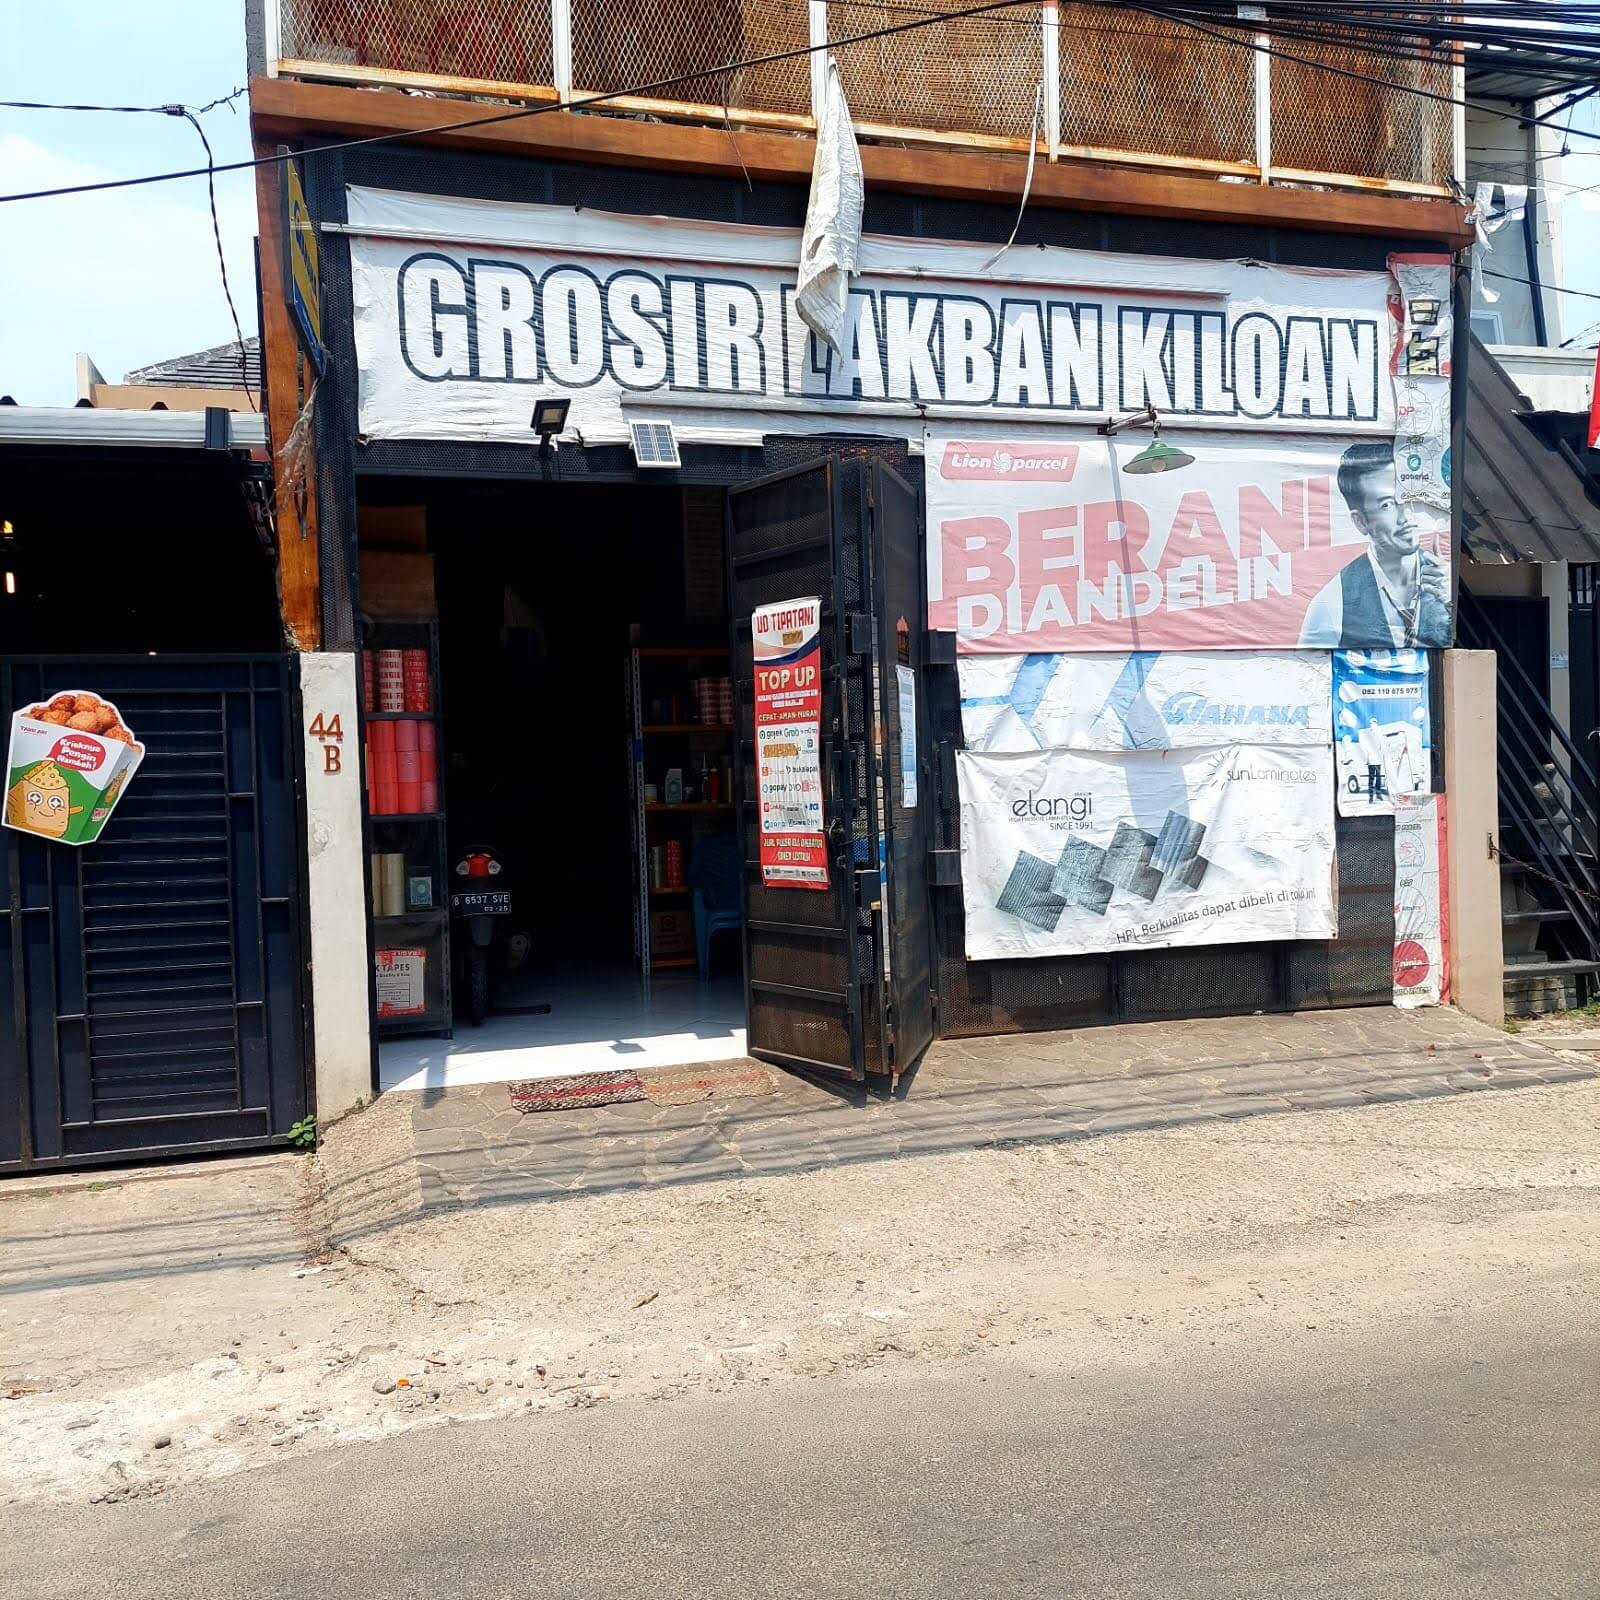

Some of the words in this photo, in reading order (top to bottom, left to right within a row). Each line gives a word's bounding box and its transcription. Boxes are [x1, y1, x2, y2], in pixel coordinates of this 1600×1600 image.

[397, 251, 767, 396] GROSIR
[1117, 305, 1378, 420] KILOAN
[951, 453, 991, 468] Lion
[1011, 456, 1069, 471] parcel
[940, 476, 1331, 602] BERANI
[759, 669, 790, 691] TOP
[794, 665, 815, 688] UP
[309, 712, 343, 741] 44
[323, 744, 341, 774] B
[1012, 790, 1092, 821] elangi
[1049, 822, 1073, 831] SINCE
[1075, 821, 1093, 830] 1991
[465, 895, 488, 905] 6537
[493, 894, 509, 903] SVE
[1141, 909, 1200, 936] Berkualitas
[1202, 900, 1237, 918] dapat
[1239, 891, 1274, 909] dibeli
[1277, 889, 1288, 902] di
